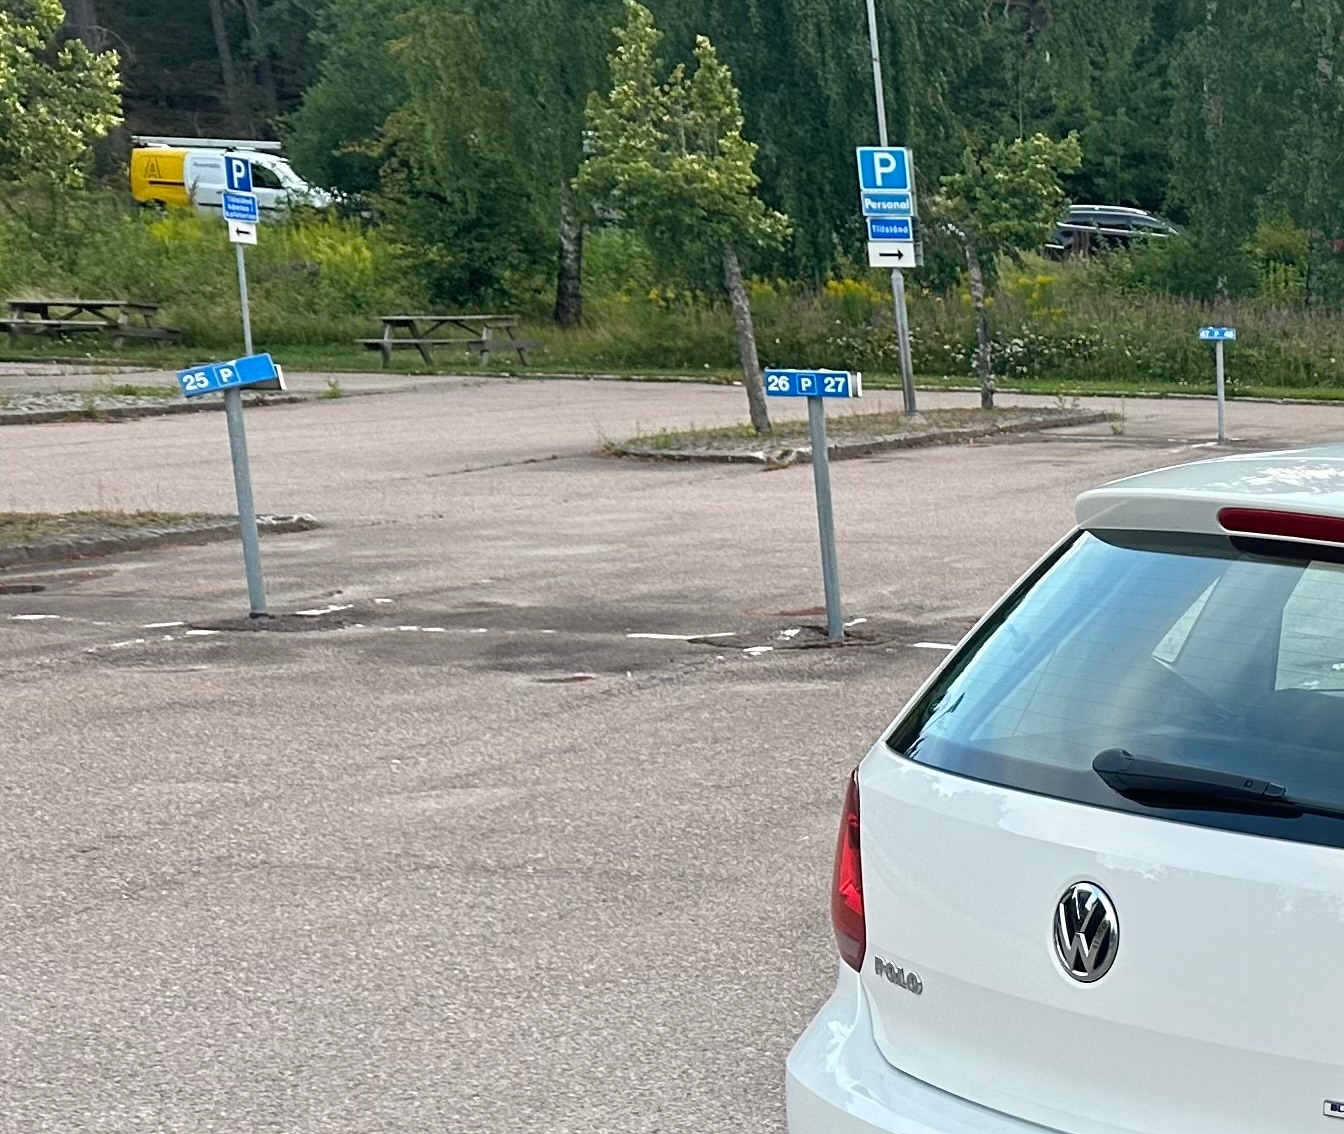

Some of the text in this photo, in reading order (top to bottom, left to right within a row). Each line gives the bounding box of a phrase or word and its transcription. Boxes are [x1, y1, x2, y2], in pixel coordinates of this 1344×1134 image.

[231, 159, 246, 188] P
[873, 152, 897, 187] P
[864, 198, 910, 210] Personal
[182, 368, 233, 391] 25 P
[767, 374, 846, 393] 26 P 27
